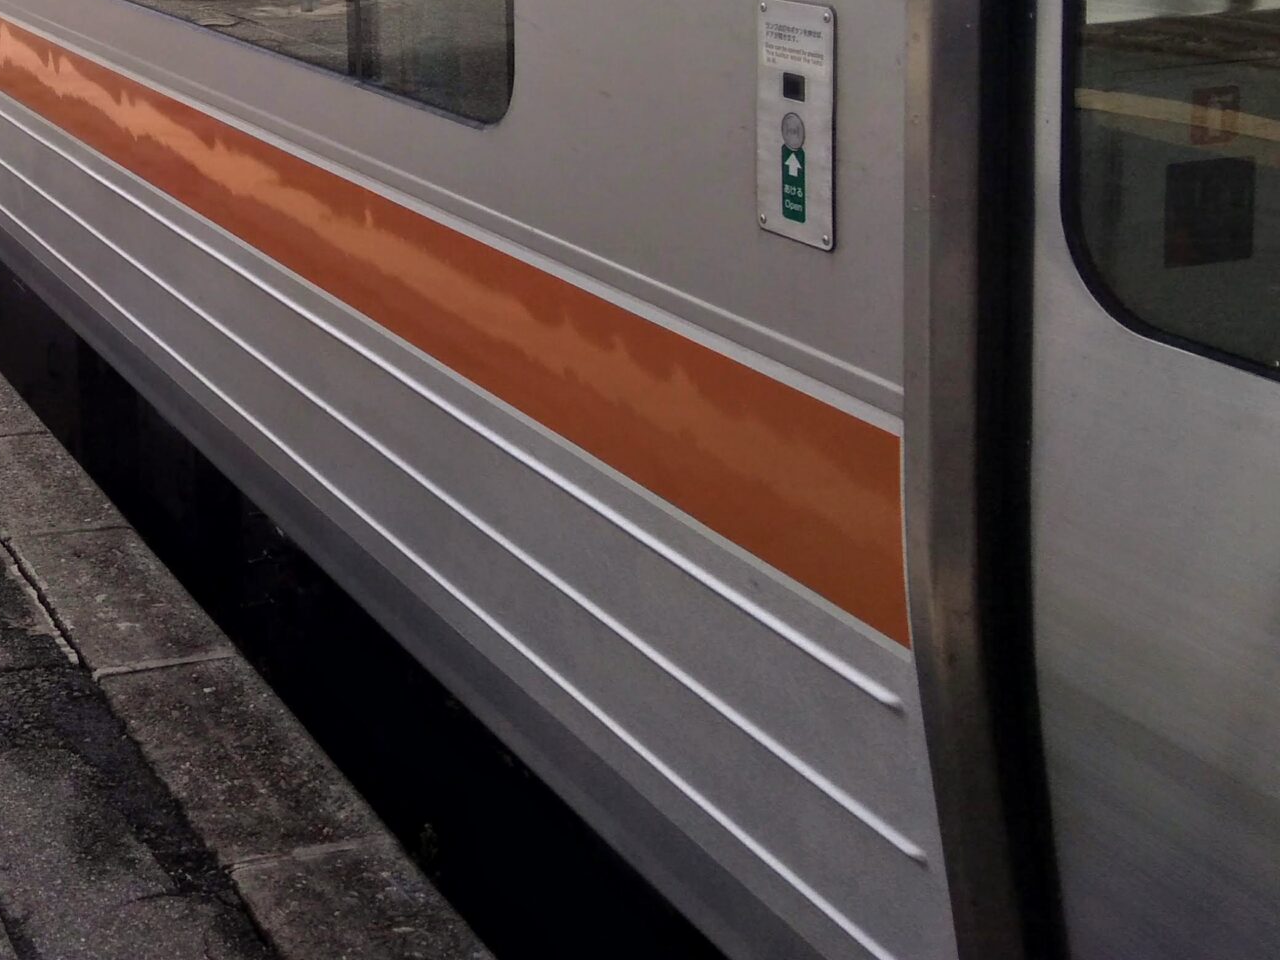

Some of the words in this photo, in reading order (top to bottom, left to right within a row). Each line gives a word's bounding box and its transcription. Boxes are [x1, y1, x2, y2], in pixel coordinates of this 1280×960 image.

[784, 183, 803, 198] あける
[784, 198, 802, 212] Open
